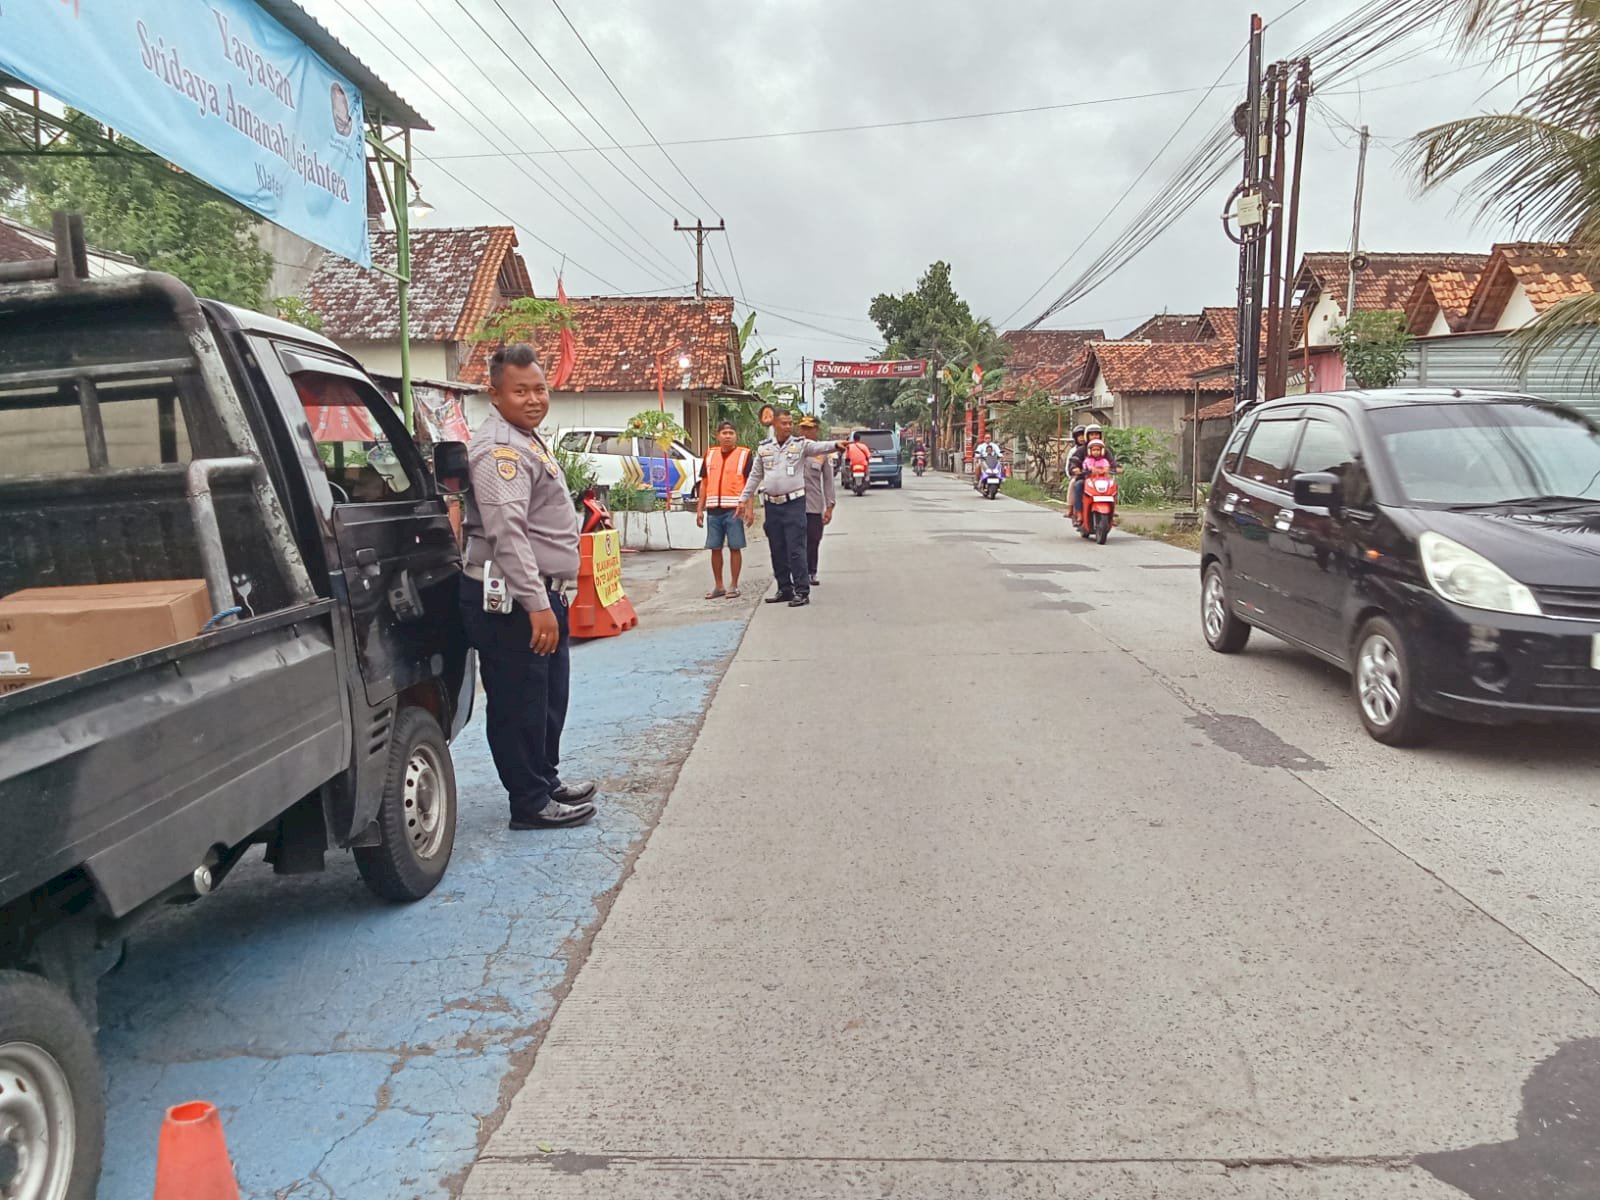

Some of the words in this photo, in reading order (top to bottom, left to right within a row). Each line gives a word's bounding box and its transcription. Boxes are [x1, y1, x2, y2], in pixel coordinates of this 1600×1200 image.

[136, 19, 221, 117] Sridaya
[225, 82, 290, 162] Amanah
[211, 8, 296, 110] Yayasan
[815, 363, 851, 374] SENIOR
[876, 364, 889, 374] 16
